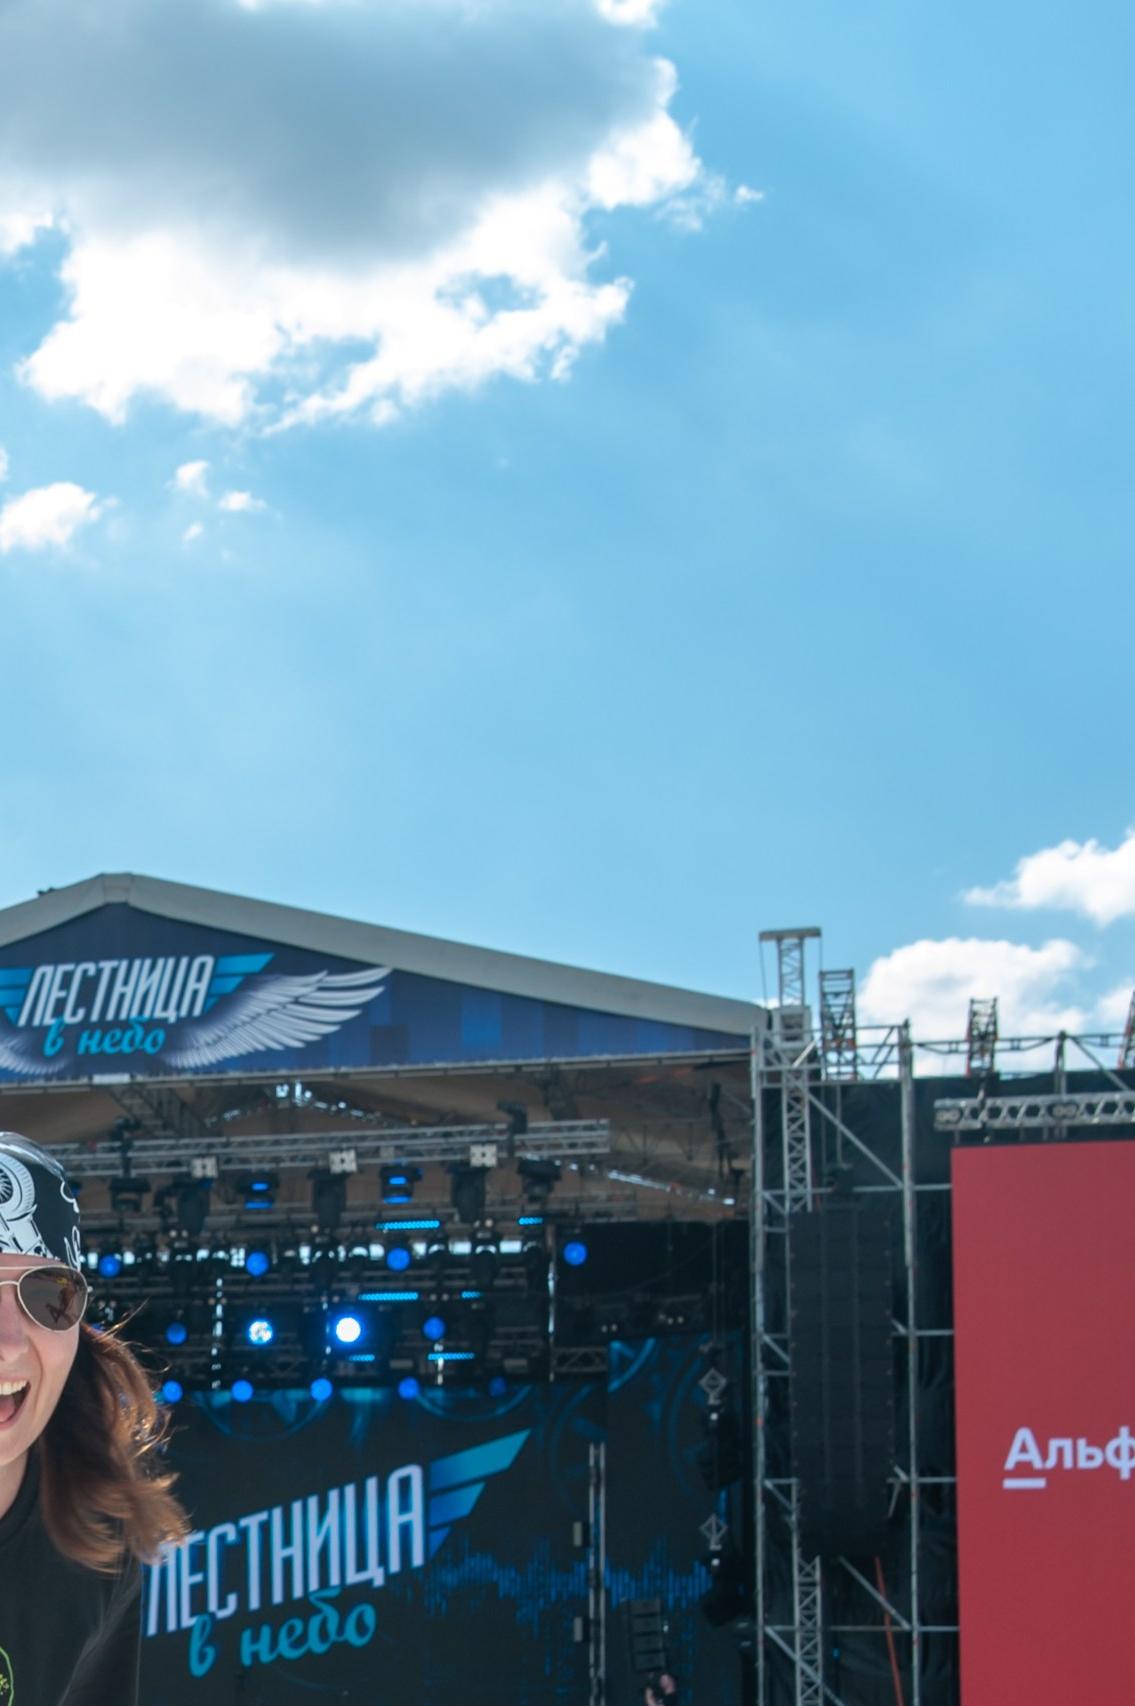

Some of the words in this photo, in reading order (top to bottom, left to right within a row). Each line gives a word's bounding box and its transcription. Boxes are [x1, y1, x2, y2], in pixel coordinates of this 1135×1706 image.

[17, 955, 215, 1027] ЛЕСТНИЦА
[43, 1017, 65, 1057] в
[77, 1017, 166, 1055] небо
[146, 1464, 424, 1637] ЛЕСТНИЦА
[188, 1612, 216, 1678] в
[240, 1586, 377, 1667] небо
